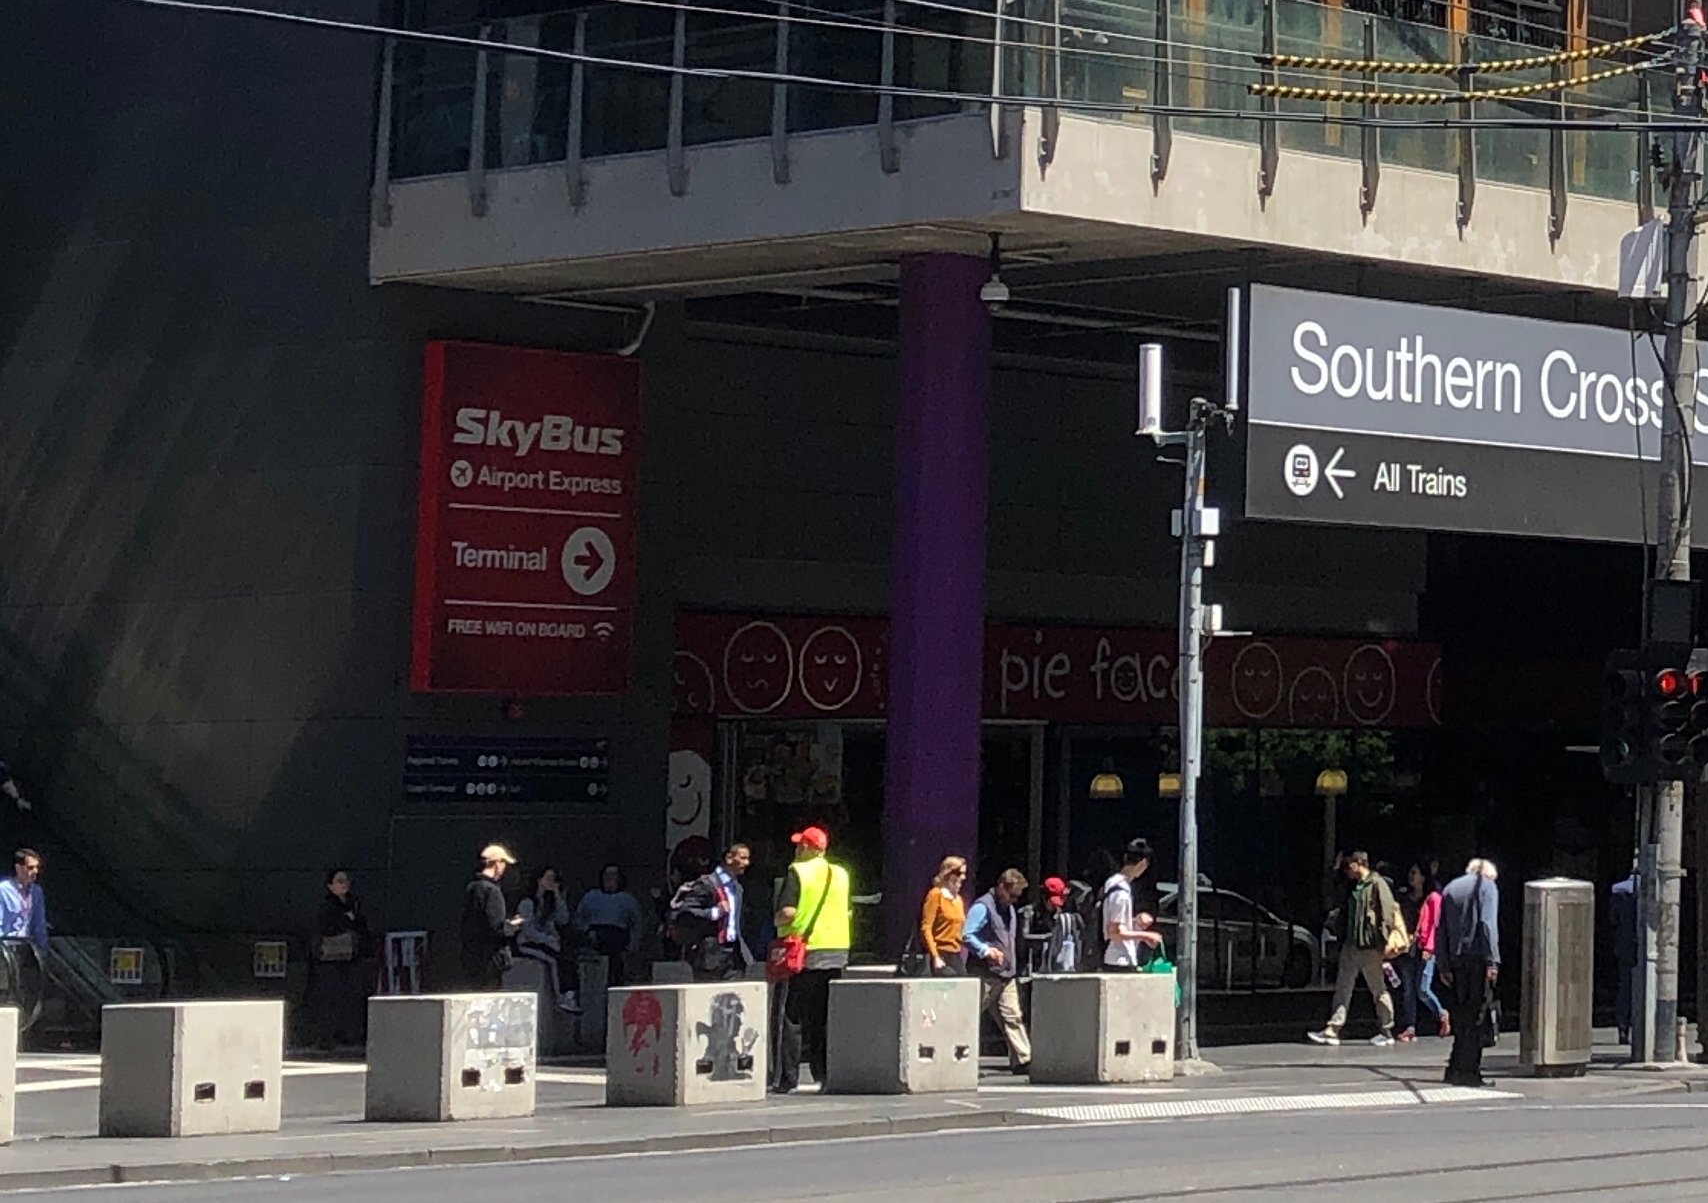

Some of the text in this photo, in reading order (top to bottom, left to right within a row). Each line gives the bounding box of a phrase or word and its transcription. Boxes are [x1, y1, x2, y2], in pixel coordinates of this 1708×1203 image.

[1291, 320, 1522, 415] Southern
[452, 407, 625, 457] SkyBus
[477, 465, 623, 496] Airport Express
[1374, 461, 1468, 498] All Trains
[451, 541, 548, 572] Terminal
[447, 619, 483, 635] FREE
[515, 622, 537, 637] ON
[538, 623, 586, 639] BOARD
[1000, 628, 1072, 715] pie
